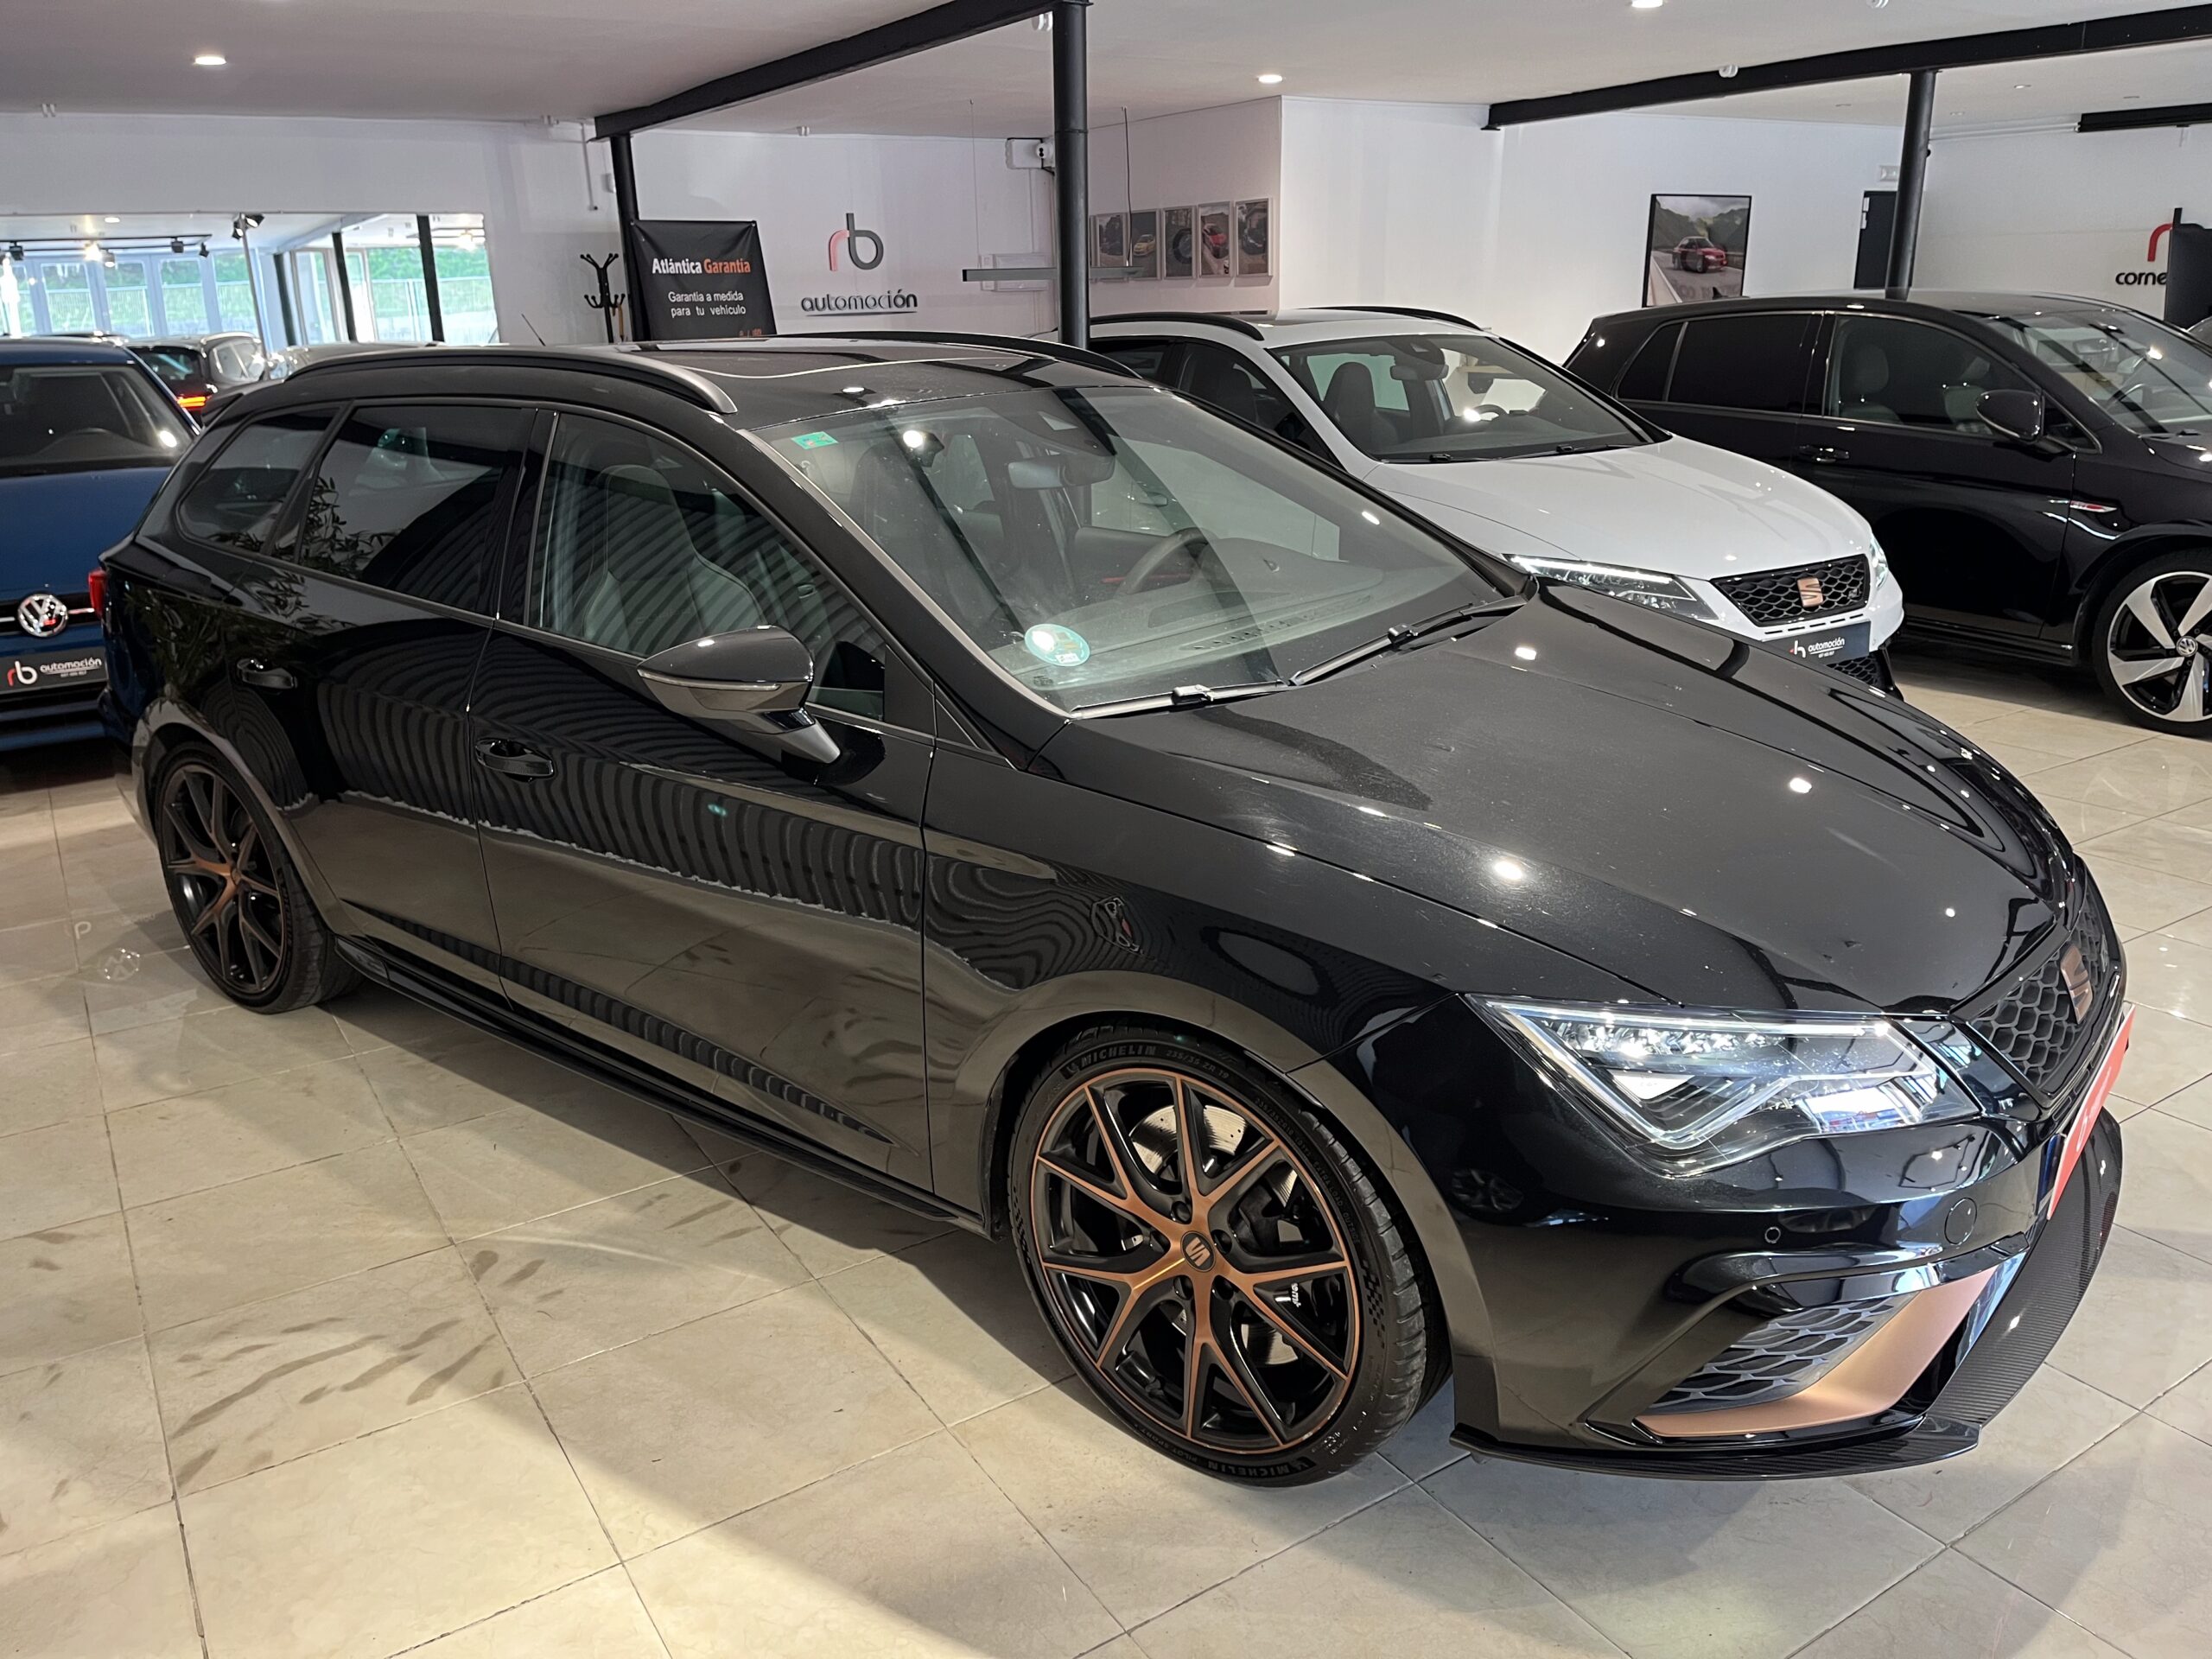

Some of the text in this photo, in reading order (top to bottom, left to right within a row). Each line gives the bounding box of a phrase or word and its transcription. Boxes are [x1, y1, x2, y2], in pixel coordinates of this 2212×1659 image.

[652, 258, 702, 274] Atlántica
[2115, 271, 2167, 286] corne
[706, 293, 712, 302] a
[713, 290, 744, 302] medida
[801, 289, 918, 312] automoción
[671, 307, 691, 319] para
[696, 305, 705, 316] tu
[1808, 637, 1846, 652] automoción
[40, 657, 102, 673] automoción
[1082, 1045, 1157, 1067] MICHELIN
[1208, 1460, 1291, 1478] MICHELIN
